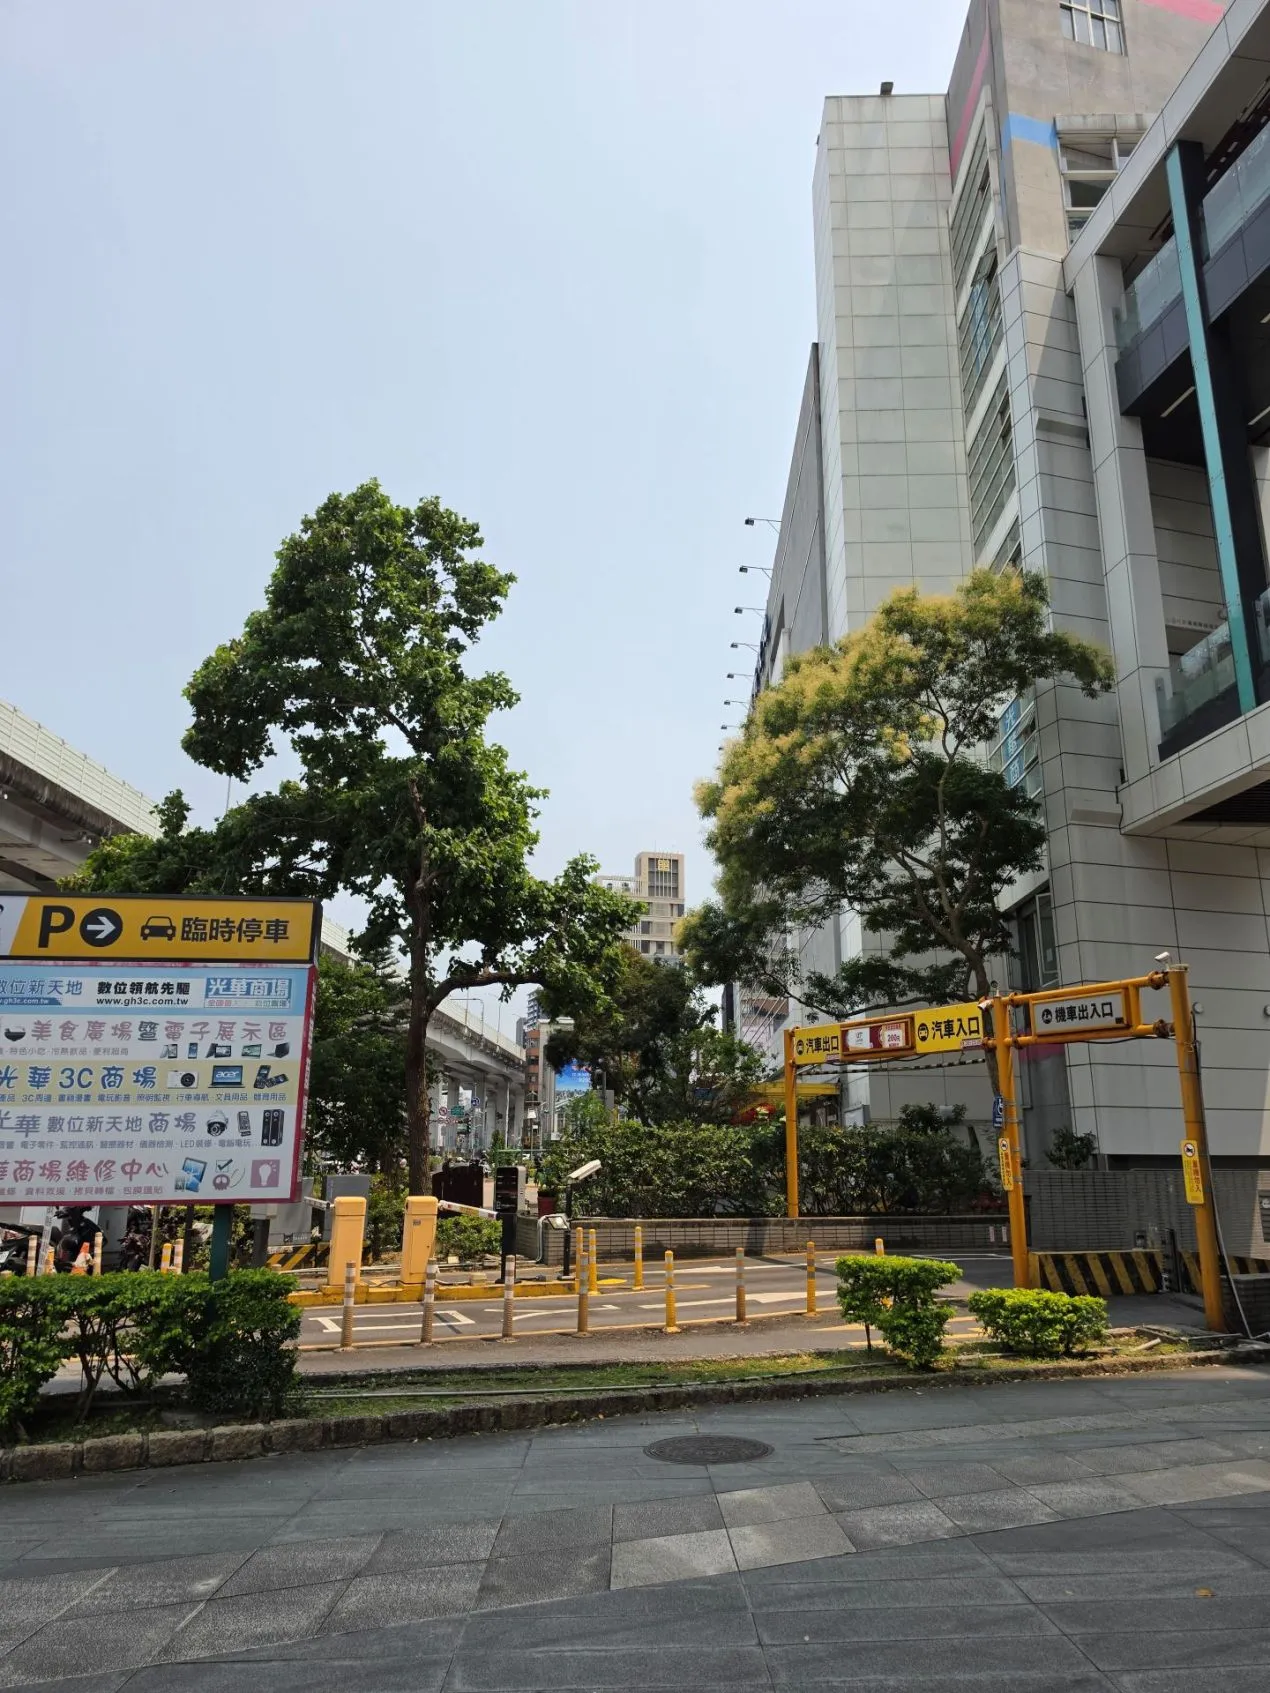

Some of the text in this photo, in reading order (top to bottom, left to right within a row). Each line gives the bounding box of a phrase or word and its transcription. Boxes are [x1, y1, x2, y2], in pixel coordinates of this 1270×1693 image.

[38, 904, 76, 949] P
[180, 916, 290, 944] 臨時停車
[207, 978, 290, 999] 光華商場
[96, 996, 189, 1007] www.gh3c.com.tw
[1055, 1001, 1114, 1024] 機車出入口
[931, 1016, 980, 1041] 汽車入口
[806, 1035, 840, 1054] 汽車出口
[216, 1069, 240, 1077] acer
